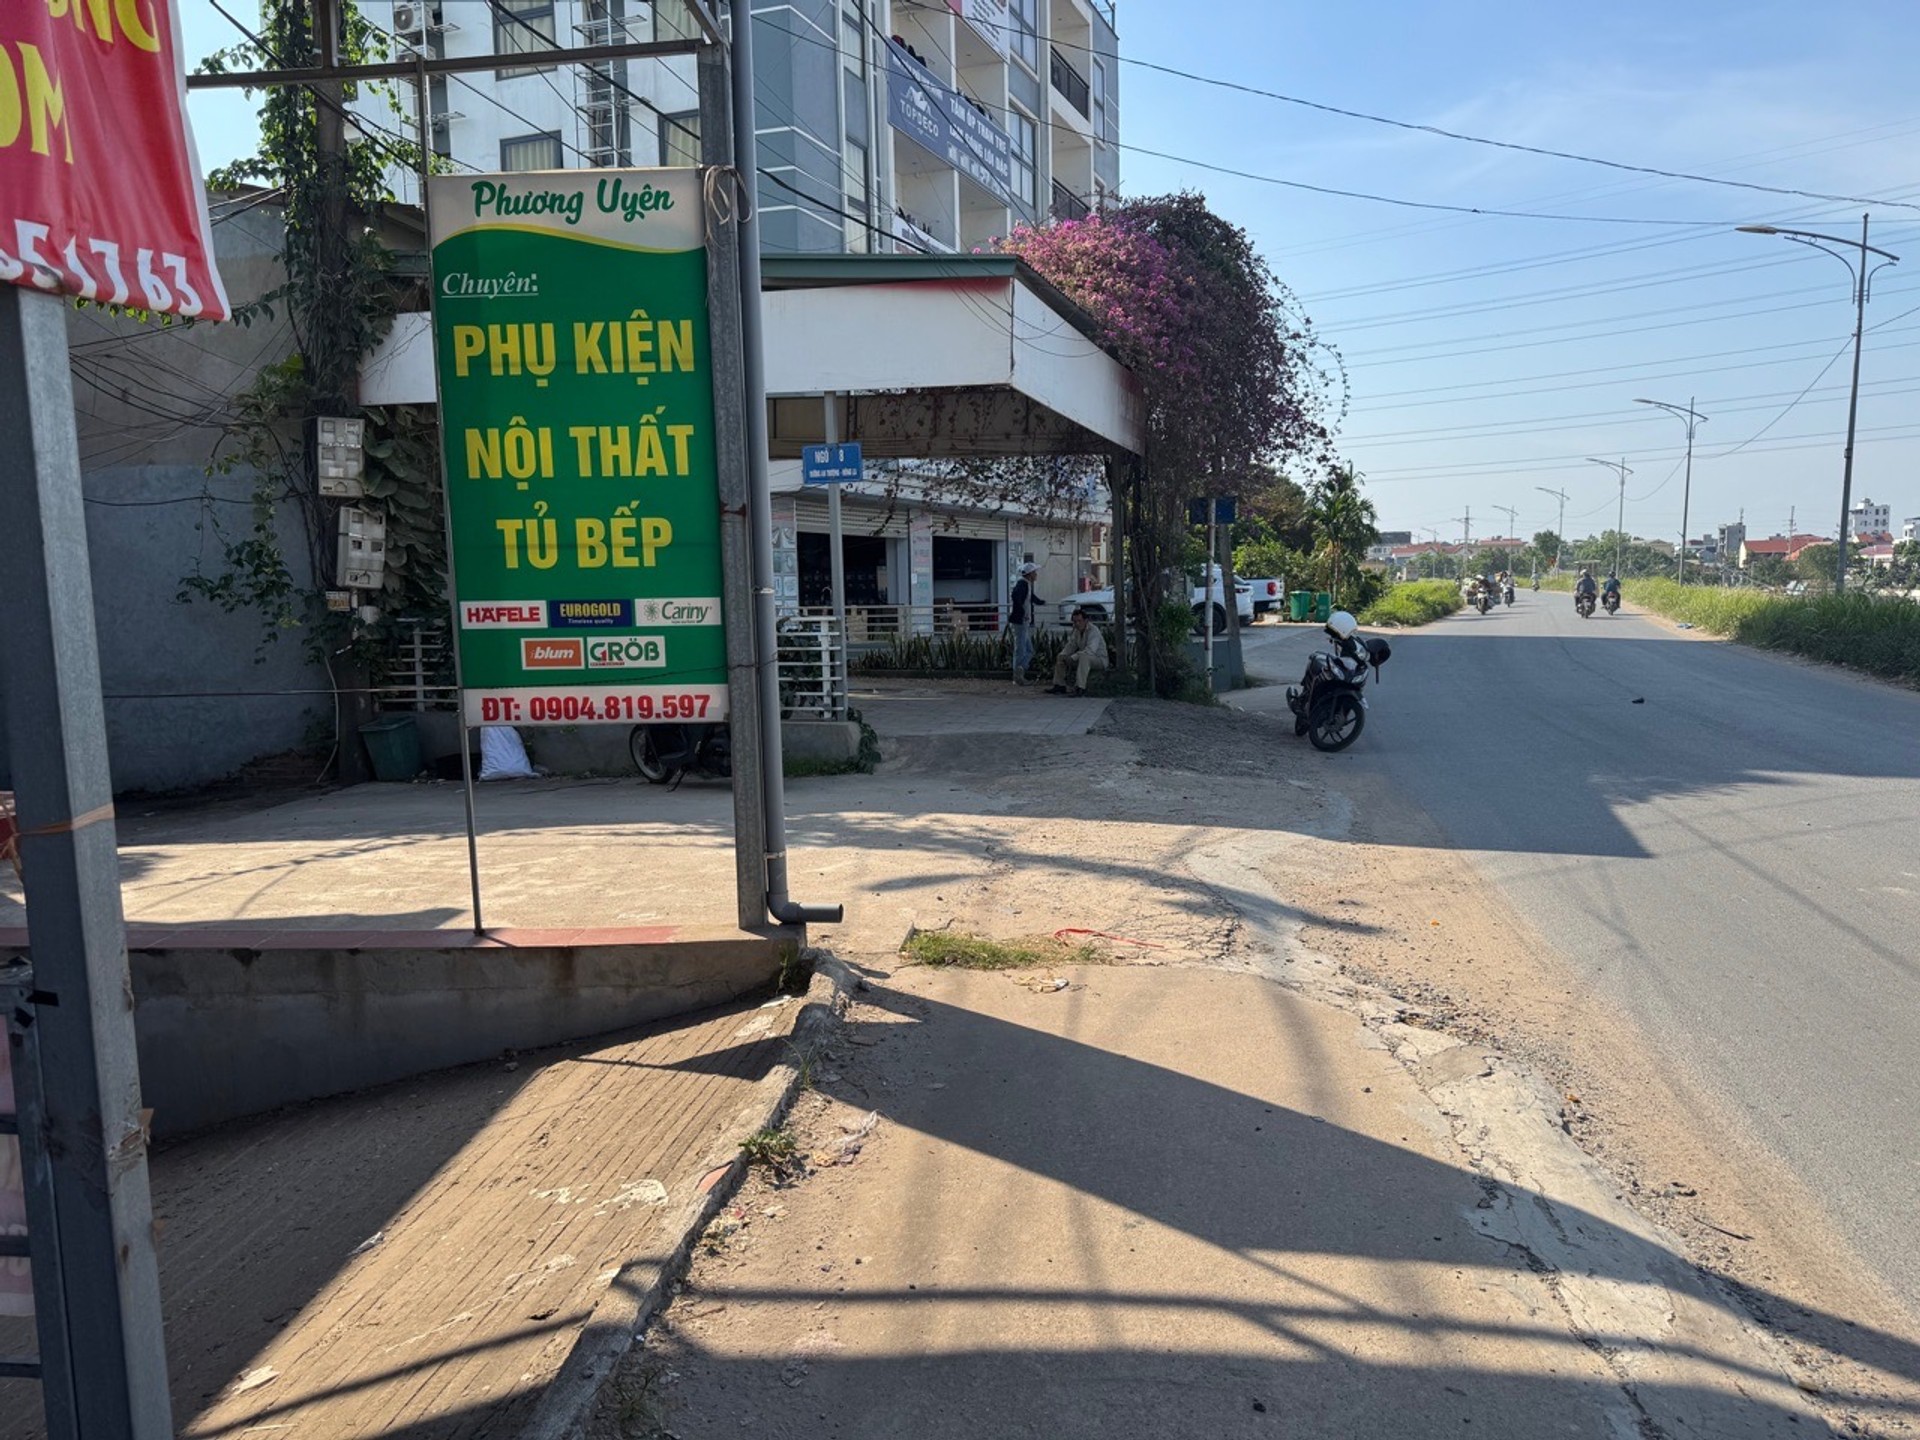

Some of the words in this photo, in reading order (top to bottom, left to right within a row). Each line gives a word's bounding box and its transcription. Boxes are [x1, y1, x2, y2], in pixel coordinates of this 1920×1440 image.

[900, 99, 939, 137] TOPDECO
[471, 178, 584, 225] Phương
[597, 177, 675, 223] Uyên
[441, 272, 539, 299] Chuyên:
[453, 322, 556, 387] PHỤ
[573, 308, 695, 385] KIỆN
[465, 416, 555, 490] NỘI
[569, 406, 694, 477] THẤT
[496, 500, 559, 569] TỦ
[575, 500, 673, 568] BẾP
[467, 606, 541, 623] HÄFELE
[560, 603, 621, 617] EUROGOLD
[661, 601, 709, 624] Cariny
[534, 646, 575, 660] blum
[481, 697, 521, 721] ĐT:
[529, 694, 711, 721] 0904.819.597
